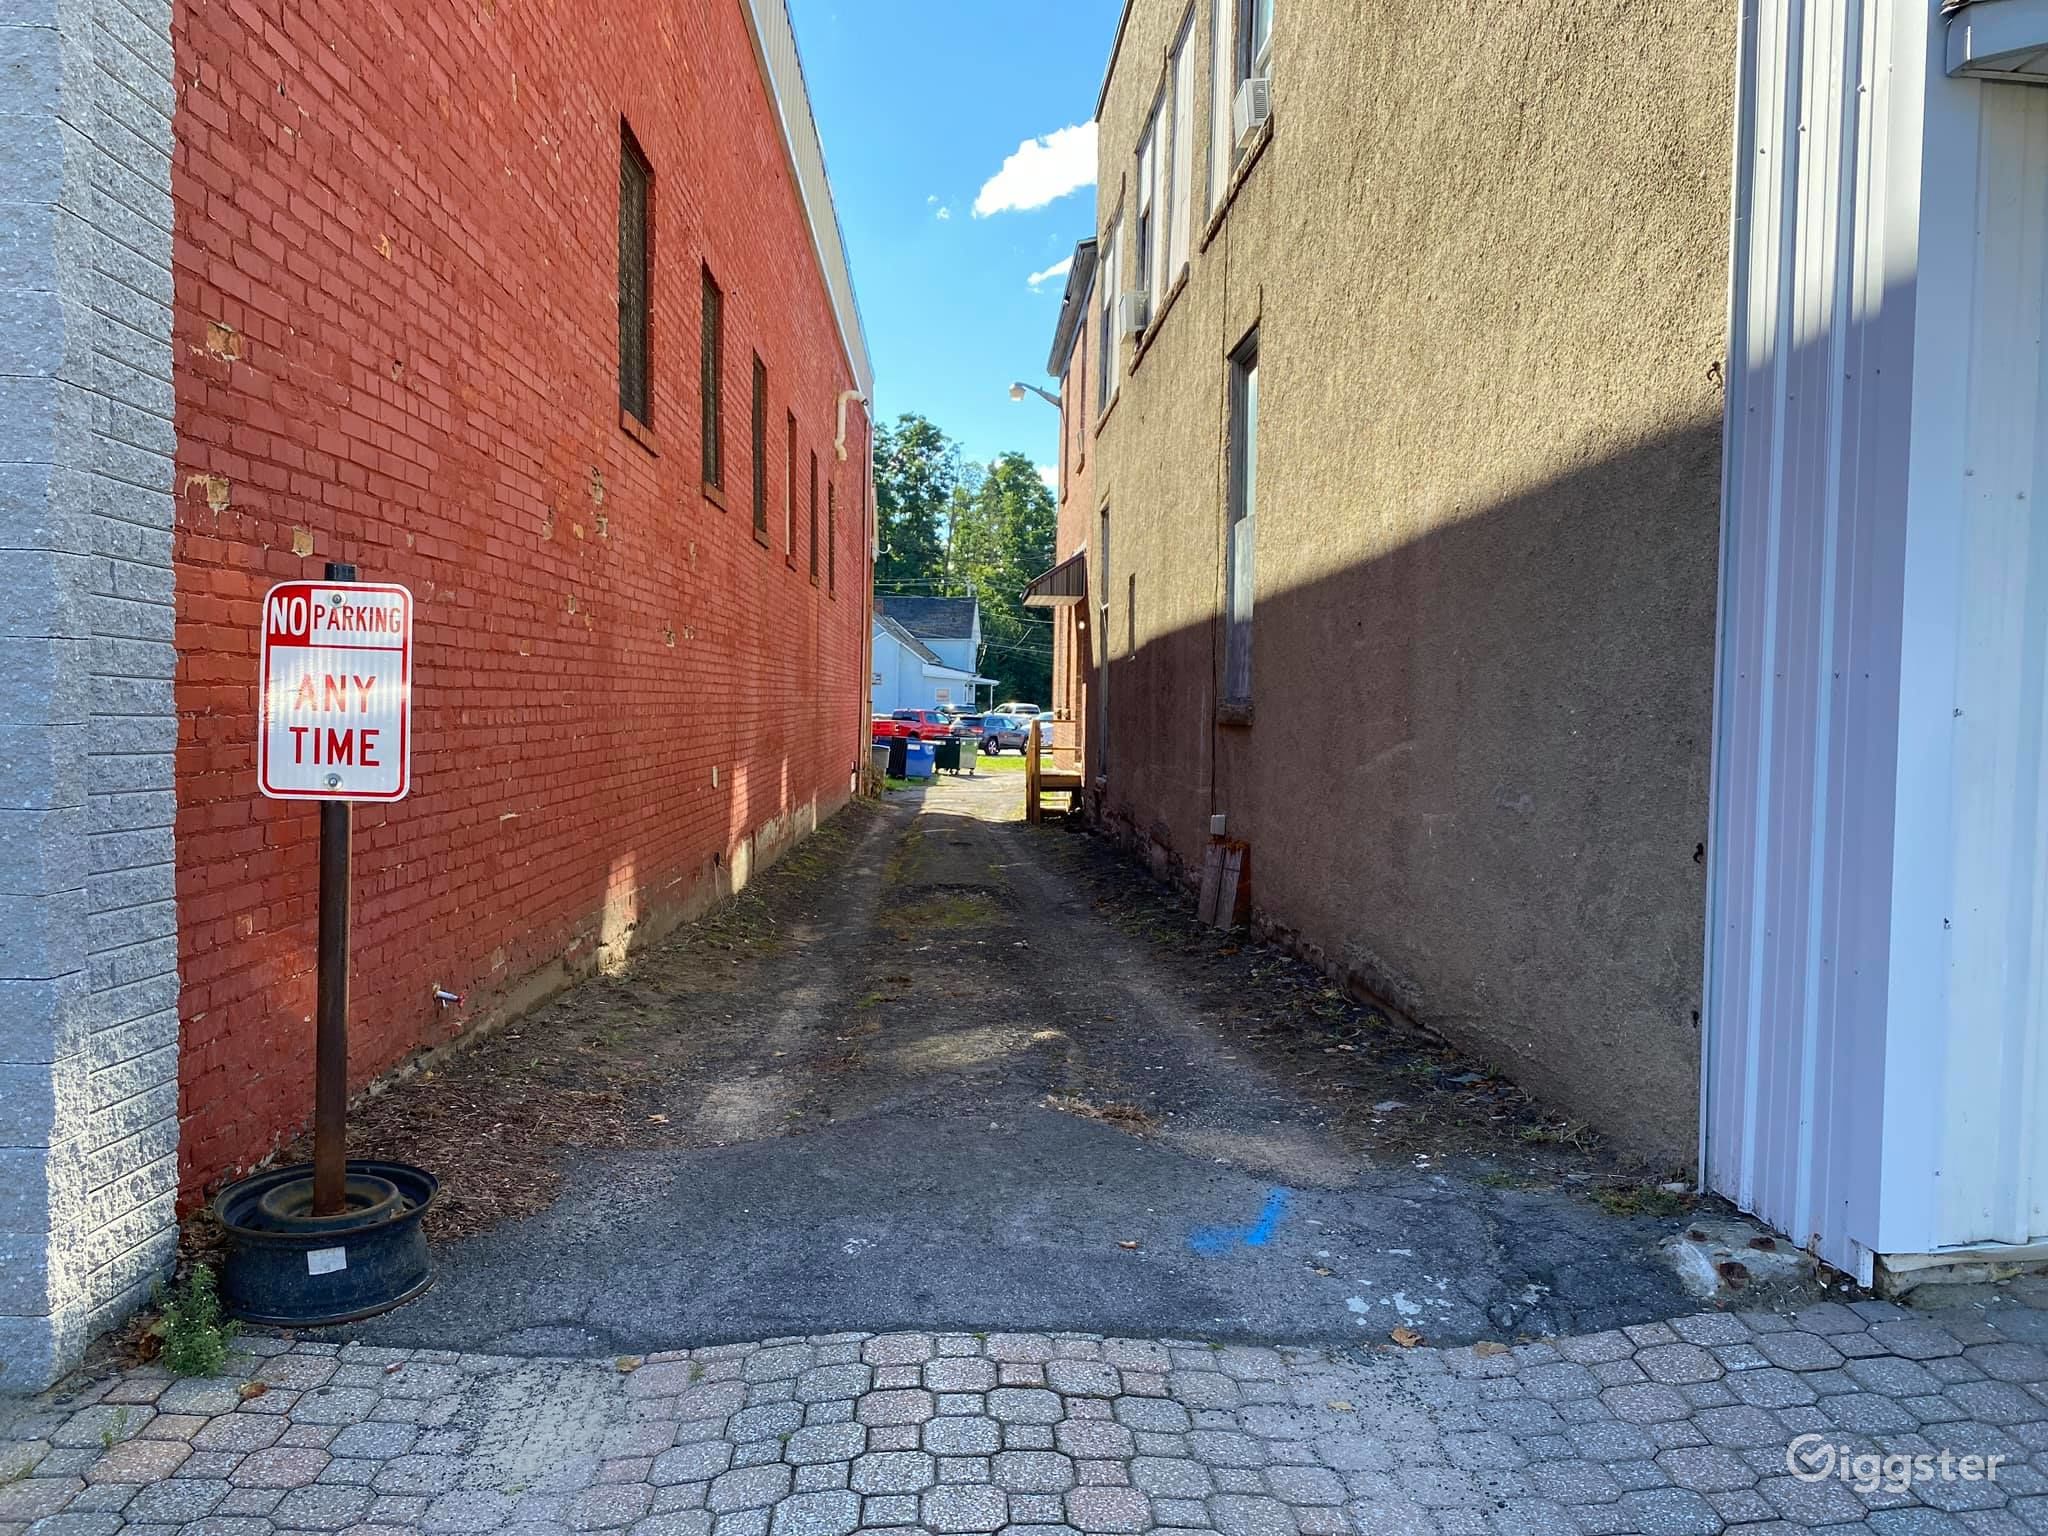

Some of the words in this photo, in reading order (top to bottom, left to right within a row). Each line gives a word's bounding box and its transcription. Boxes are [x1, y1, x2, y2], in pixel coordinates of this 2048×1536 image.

[270, 596, 308, 636] NO
[313, 604, 401, 633] PARKING
[294, 673, 377, 713] ANY
[288, 726, 380, 767] TIME
